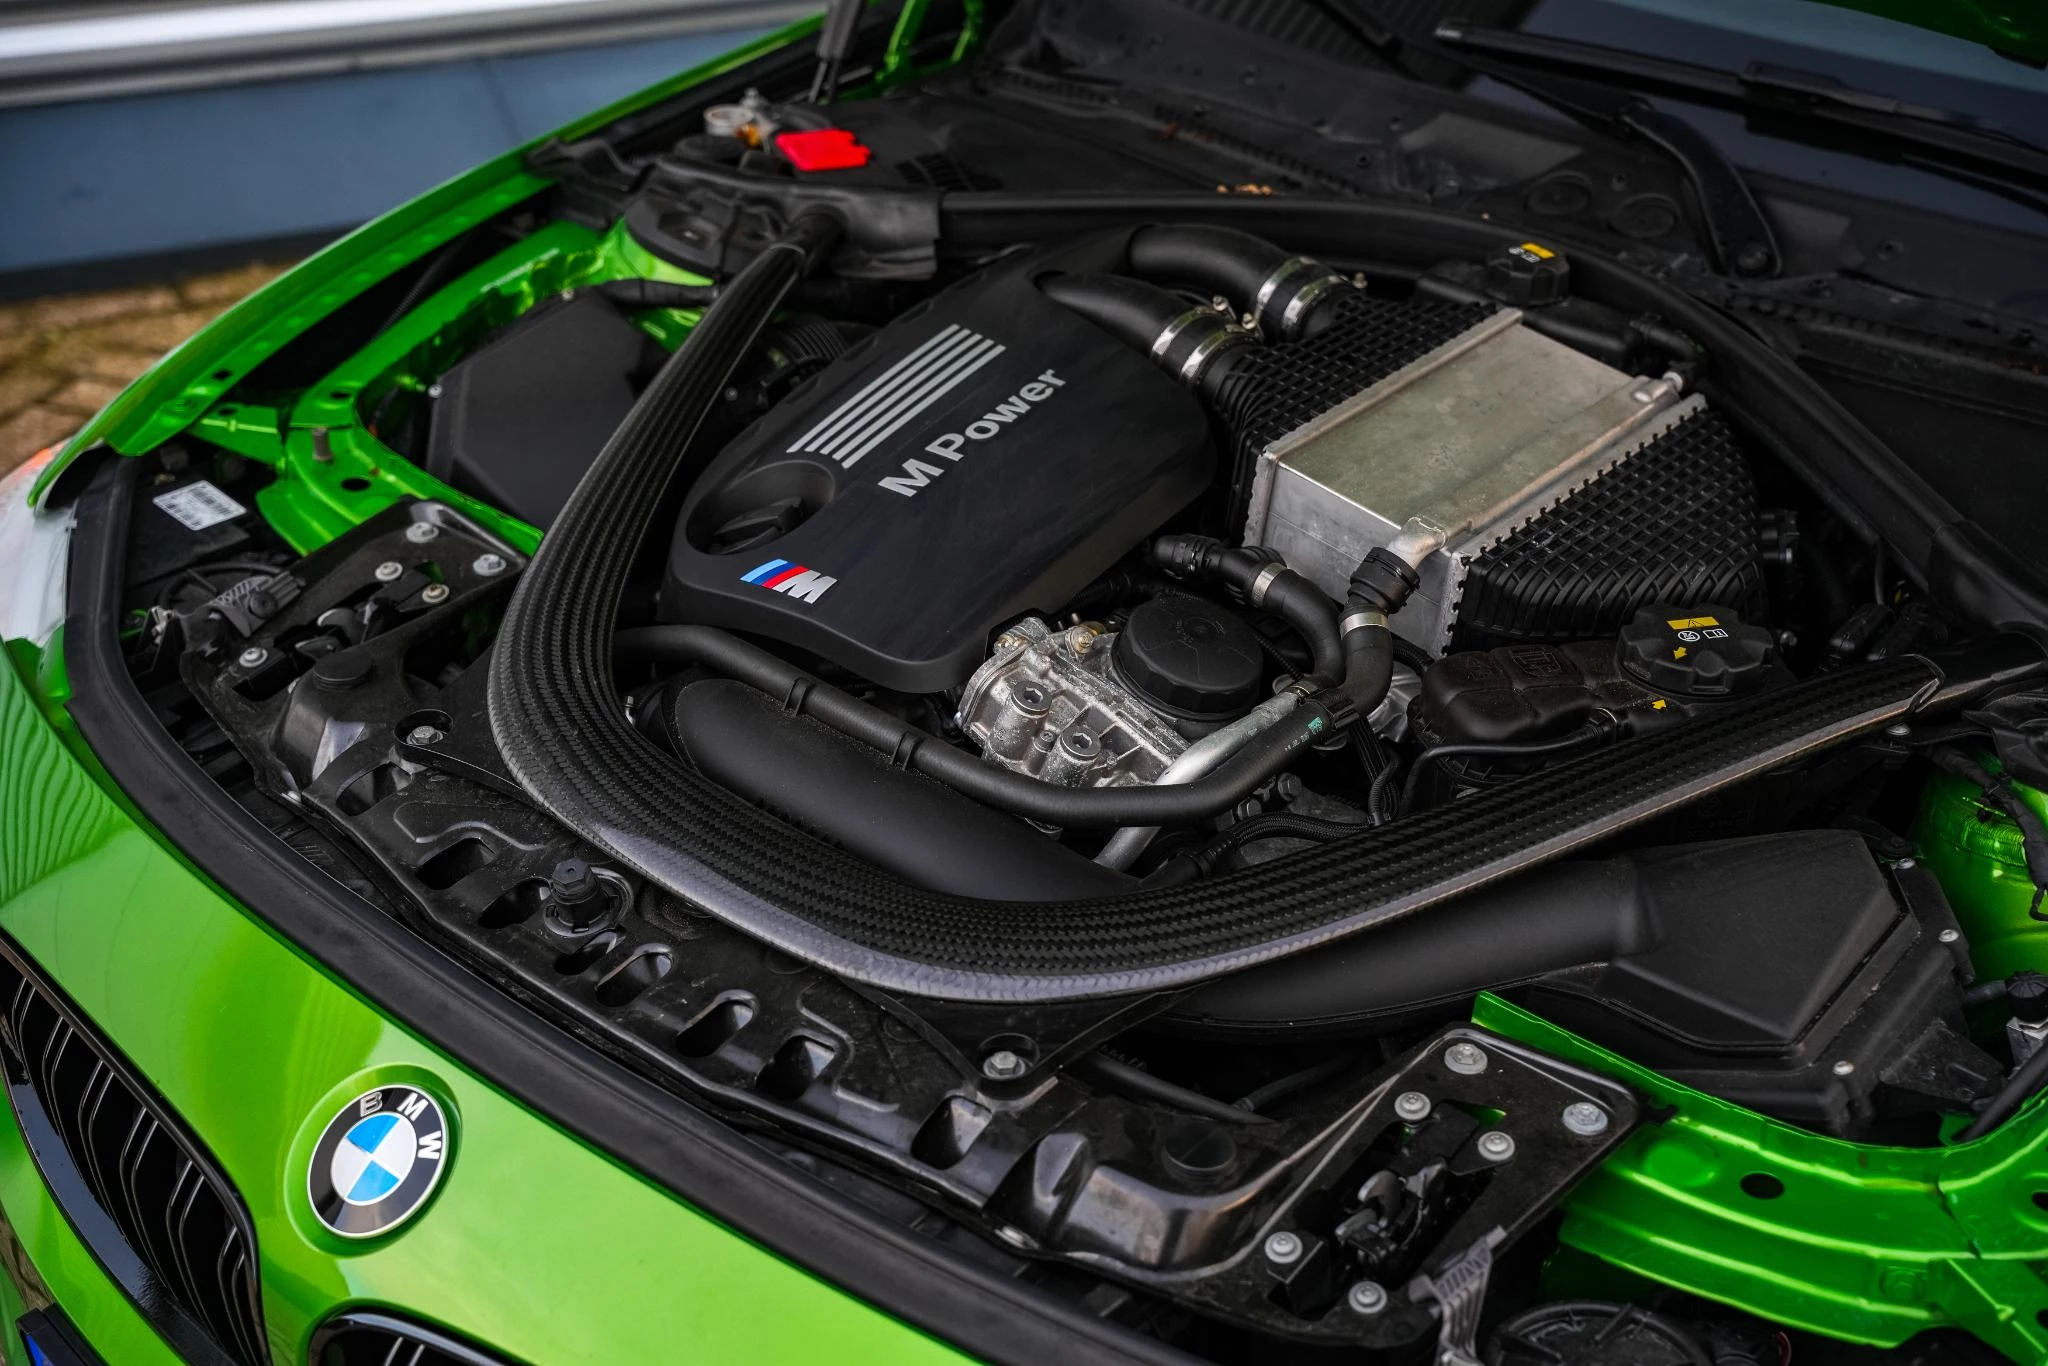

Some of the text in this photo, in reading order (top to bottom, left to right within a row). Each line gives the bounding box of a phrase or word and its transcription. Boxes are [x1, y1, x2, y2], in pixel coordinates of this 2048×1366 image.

[877, 368, 1066, 498] M Power
[769, 568, 838, 605] M
[359, 1091, 442, 1160] BMW
